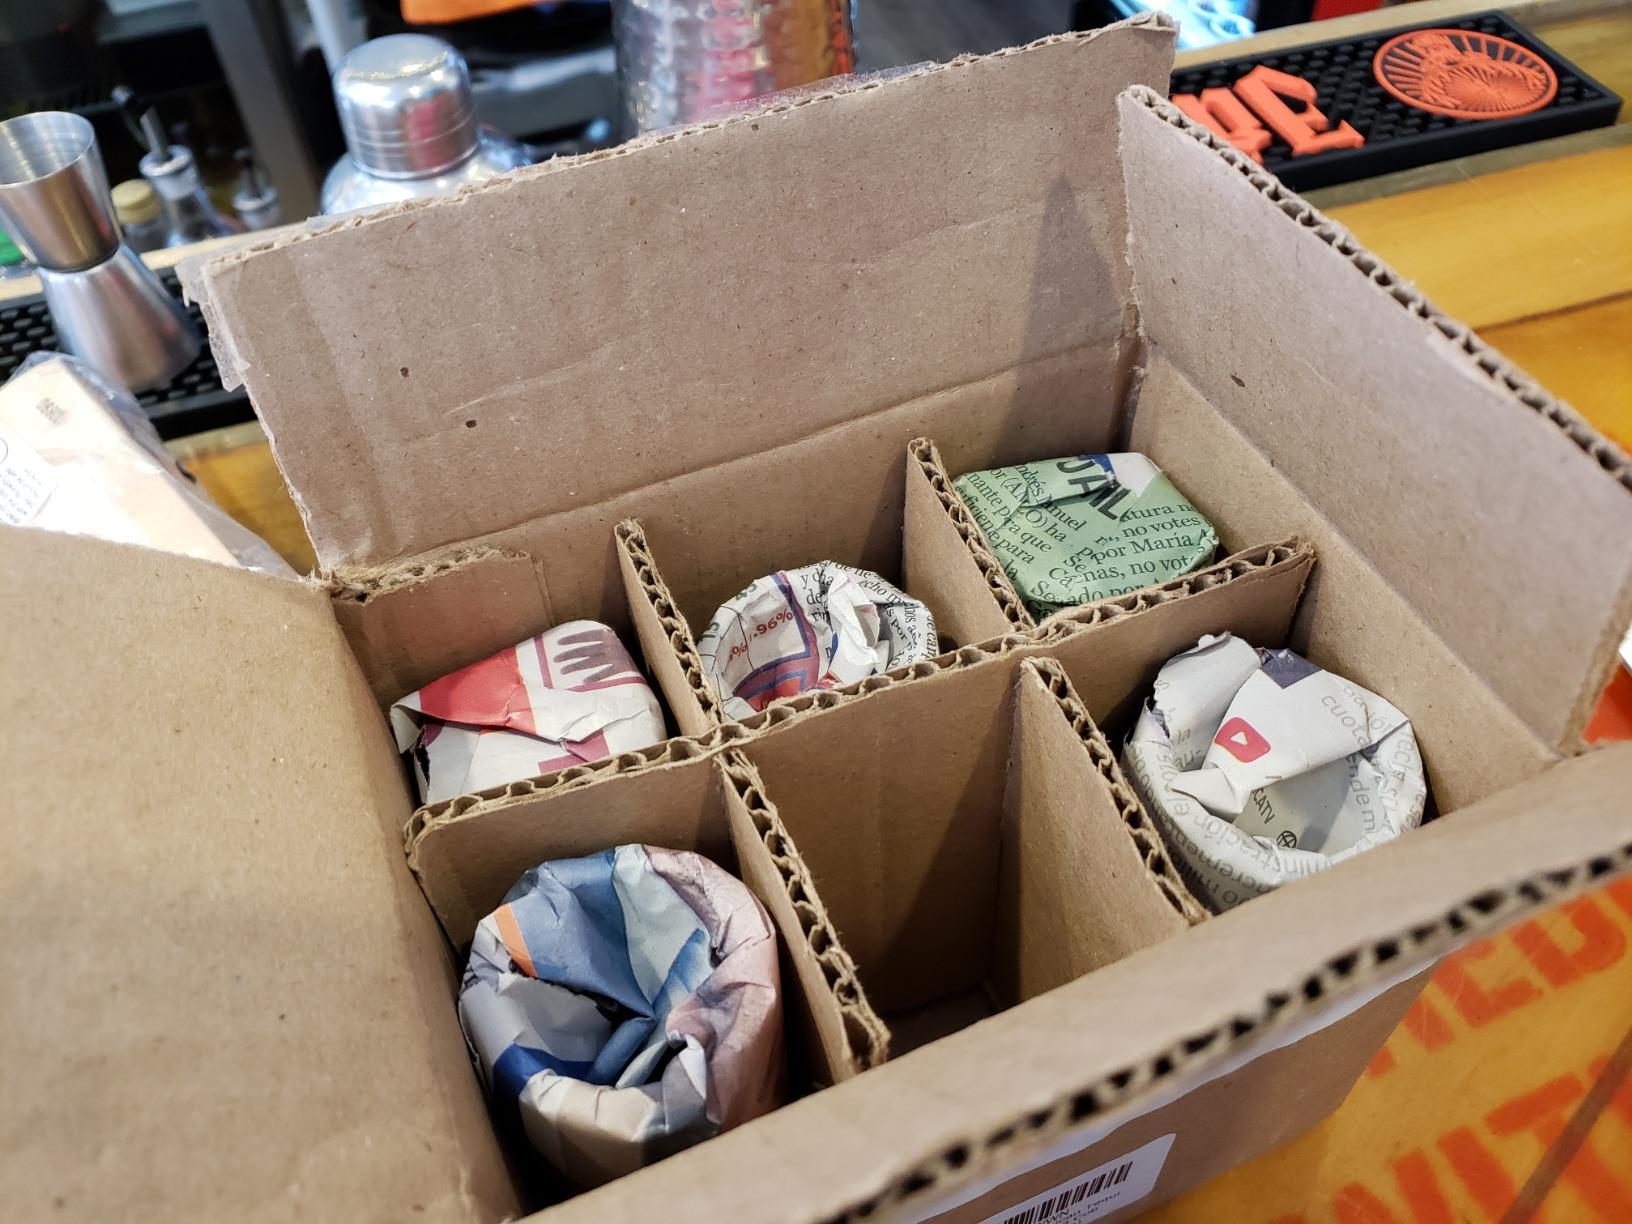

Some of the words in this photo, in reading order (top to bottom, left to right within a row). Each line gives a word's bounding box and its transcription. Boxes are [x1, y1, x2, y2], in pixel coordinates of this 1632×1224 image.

[1121, 525, 1147, 538] no
[1150, 516, 1201, 532] votes
[992, 539, 1035, 564] para
[1020, 532, 1052, 553] que
[1128, 532, 1194, 554] María
[1129, 560, 1156, 575] no
